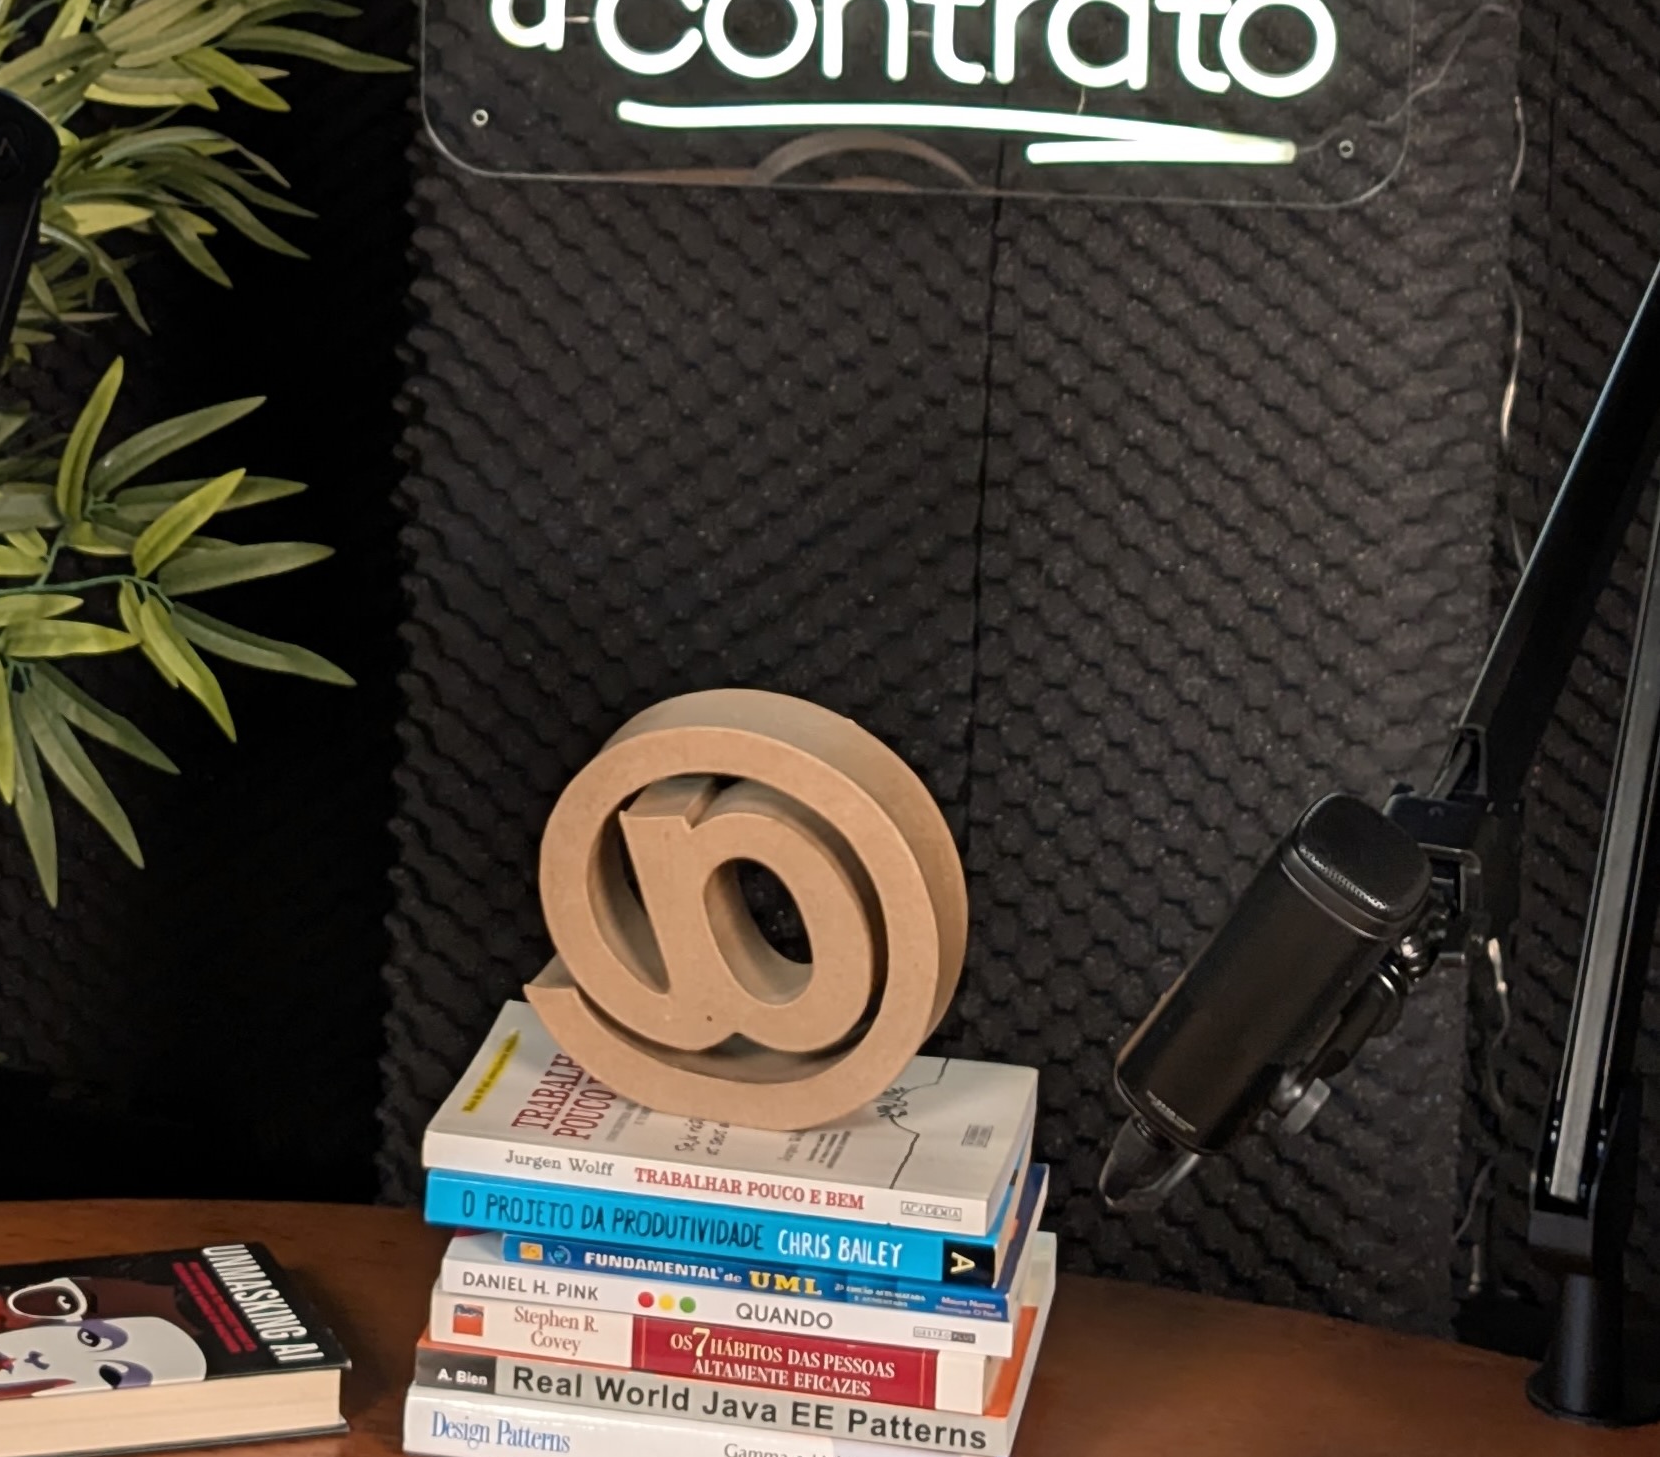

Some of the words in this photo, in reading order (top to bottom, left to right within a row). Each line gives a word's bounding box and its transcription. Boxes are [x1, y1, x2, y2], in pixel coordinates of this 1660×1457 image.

[511, 1053, 584, 1130] TRABALH
[552, 1087, 618, 1141] POUCO
[505, 1150, 562, 1170] Jurgen
[568, 1157, 615, 1176] Wolff
[635, 1167, 742, 1195] TRABALHAR
[747, 1182, 805, 1203] POUCO
[809, 1190, 822, 1204] E
[825, 1191, 865, 1210] BEM
[462, 1190, 475, 1218] O
[485, 1193, 573, 1230] PROJETO
[581, 1204, 605, 1233] DA
[612, 1207, 764, 1250] PRODUTIVIDADE
[777, 1229, 831, 1261] CHRIS
[837, 1236, 903, 1268] BAILEY
[462, 1271, 527, 1293] DANIEL
[533, 1280, 550, 1295] H.
[556, 1282, 598, 1301] PINK
[723, 1272, 742, 1284] de
[748, 1270, 822, 1296] UML
[202, 1244, 308, 1341] UNMASKING
[269, 1342, 325, 1363] AI
[514, 1305, 579, 1331] Stephen
[583, 1315, 599, 1332] R.
[736, 1302, 833, 1329] QUANDO
[531, 1330, 581, 1356] Covey
[670, 1332, 693, 1352] OS
[692, 1326, 710, 1358] 7
[710, 1337, 783, 1364] HÁBITOS
[788, 1348, 820, 1369] DAS
[823, 1354, 896, 1379] PESSOAS
[437, 1368, 453, 1382] A.
[456, 1370, 488, 1386] Bien
[692, 1358, 789, 1386] ALTAMENTE
[793, 1372, 871, 1397] EFICAZES
[513, 1365, 583, 1398] Real
[595, 1375, 690, 1412] World
[702, 1391, 778, 1424] Java
[791, 1401, 834, 1431] EE
[848, 1408, 987, 1450] Patterns
[431, 1410, 490, 1450] Design
[496, 1418, 571, 1454] Patterns
